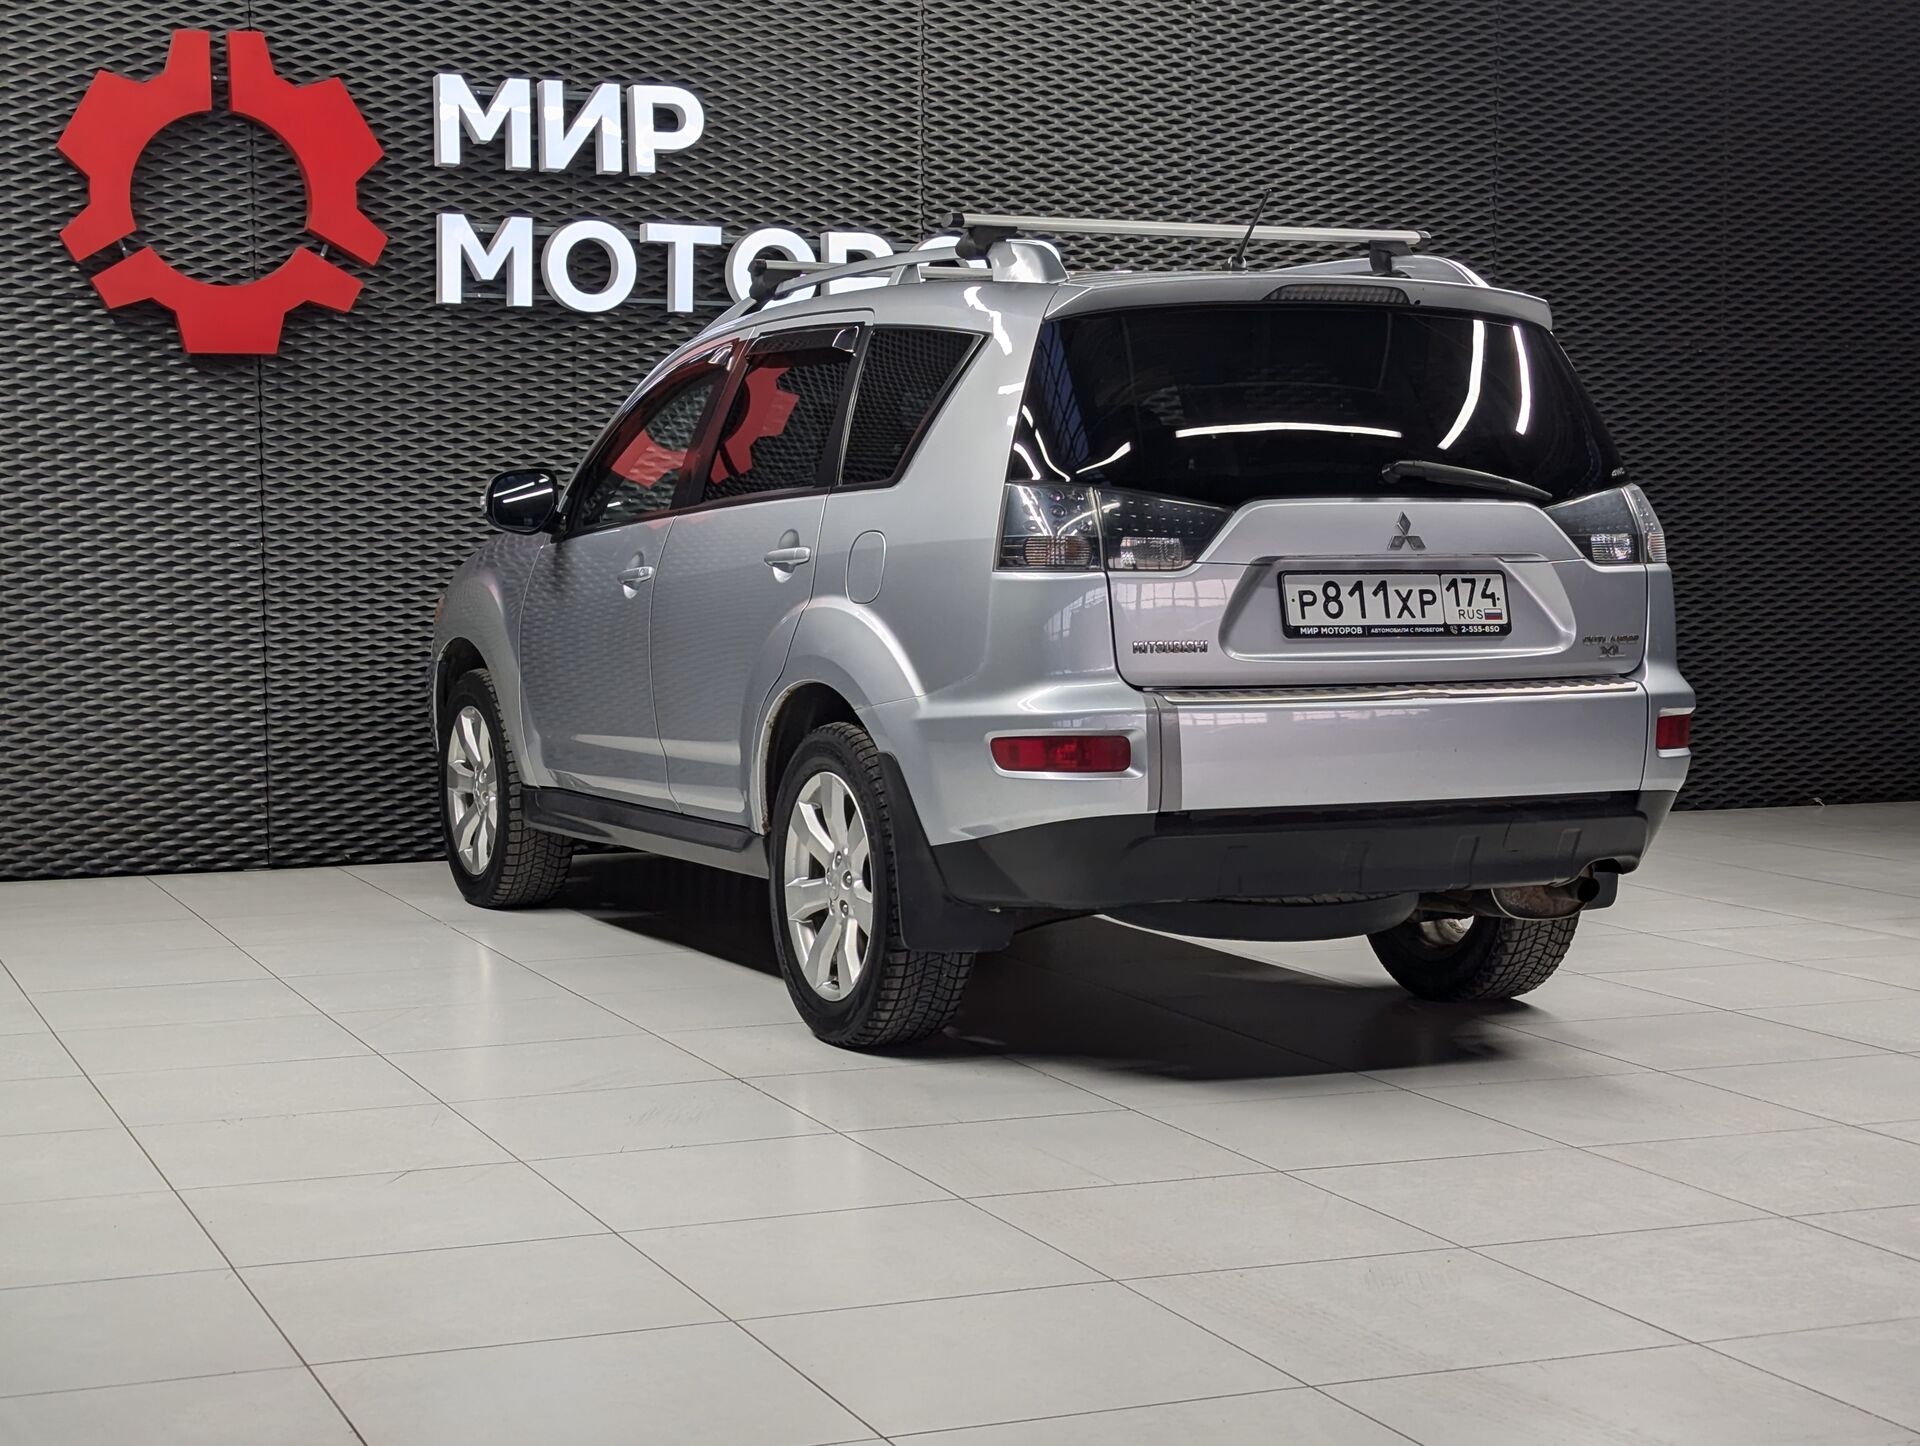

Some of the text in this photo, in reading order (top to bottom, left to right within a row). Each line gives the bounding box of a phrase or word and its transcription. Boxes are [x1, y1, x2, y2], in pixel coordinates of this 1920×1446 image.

[433, 72, 705, 177] МИР
[436, 212, 1010, 314] МОТОР
[1297, 577, 1498, 620] Р811ХР 174
[1458, 608, 1484, 620] RUS
[1300, 626, 1319, 635] МИР
[1321, 626, 1363, 635] МОТОРОВ
[1461, 625, 1500, 633] 2-555-850
[1132, 640, 1208, 654] MITSUBISHI
